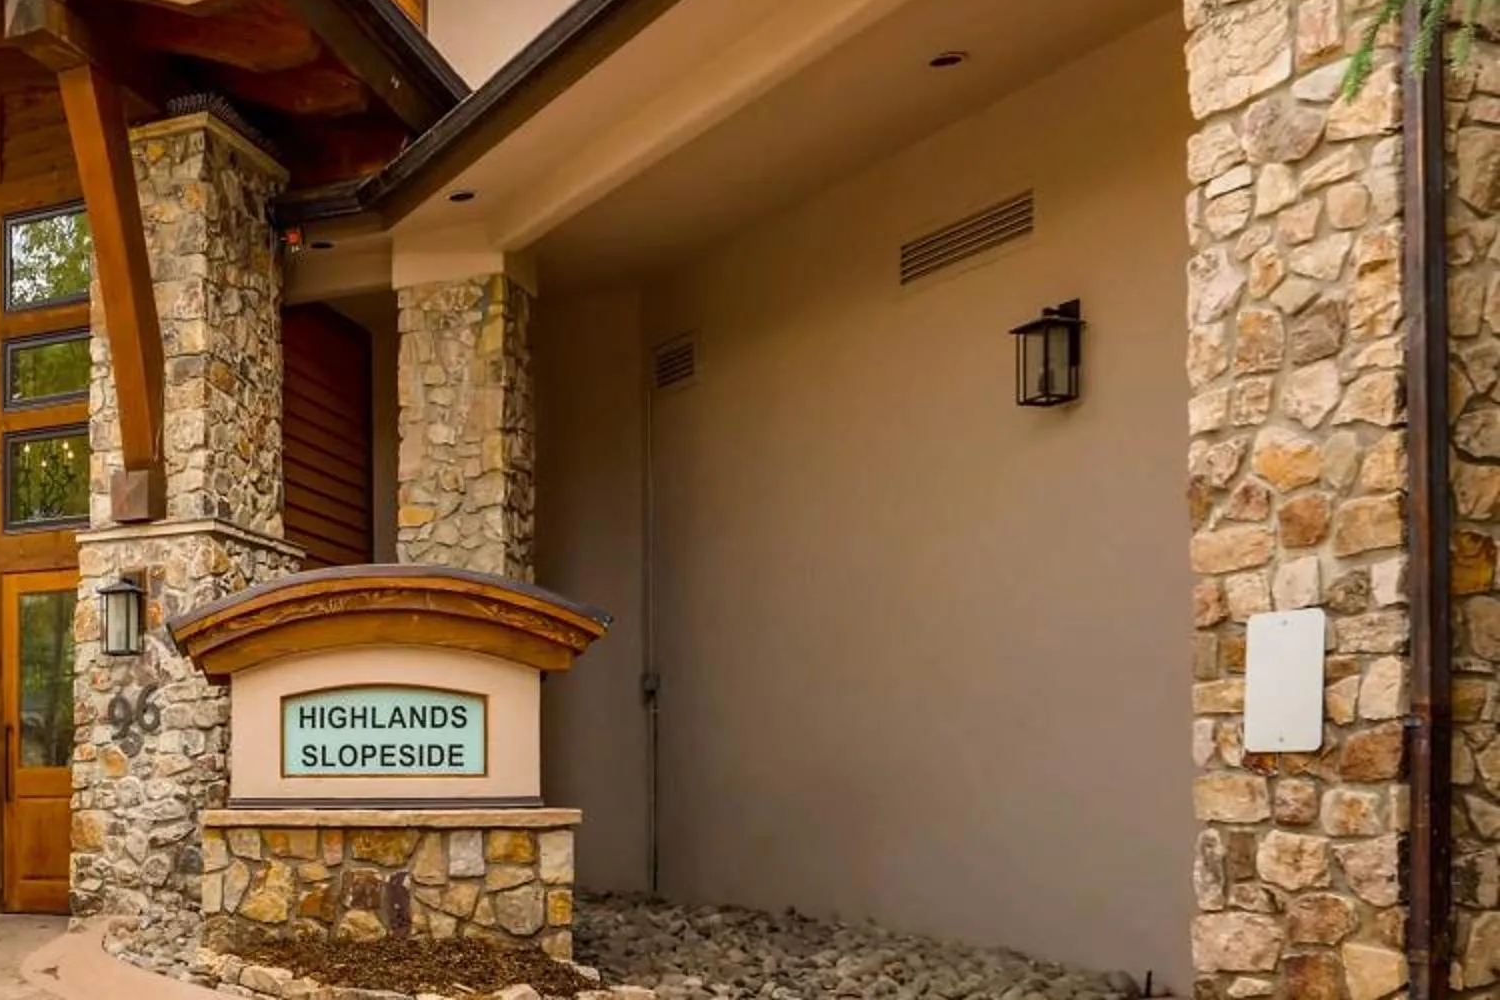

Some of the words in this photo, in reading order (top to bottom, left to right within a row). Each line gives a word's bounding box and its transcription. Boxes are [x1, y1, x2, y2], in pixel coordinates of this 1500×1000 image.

[107, 684, 161, 740] 96
[299, 705, 468, 729] HIGHLANDS
[301, 744, 465, 767] SLOPESIDE
